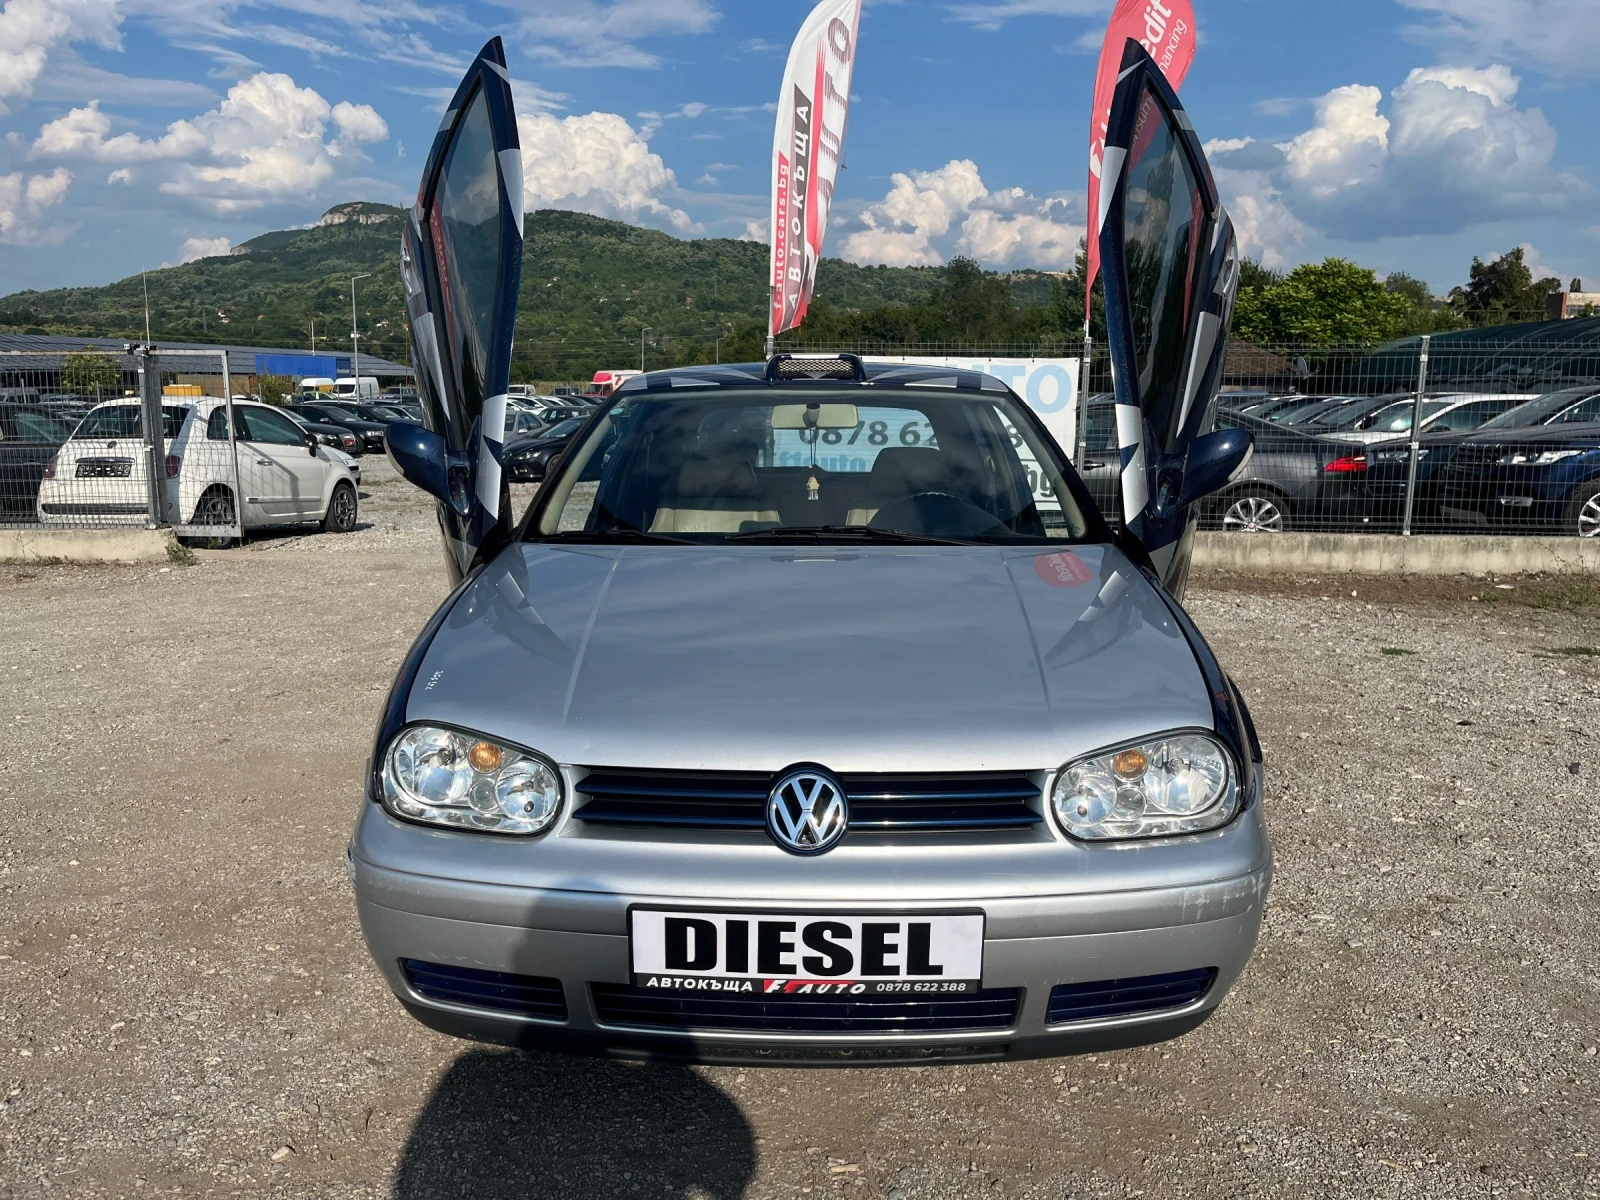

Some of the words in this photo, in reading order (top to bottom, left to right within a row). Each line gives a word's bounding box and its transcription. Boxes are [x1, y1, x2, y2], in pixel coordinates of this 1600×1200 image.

[1158, 18, 1188, 75] nancing
[788, 105, 809, 309] АВТОКЪЩА
[773, 163, 789, 309] f-auto.cars.bg
[899, 421, 938, 447] 62
[664, 917, 944, 977] DIESEL
[646, 976, 753, 992] АВТОКЪЩА
[797, 982, 866, 995] AUTO
[876, 983, 911, 992] 0878
[914, 983, 938, 992] 622
[941, 983, 966, 992] 388
